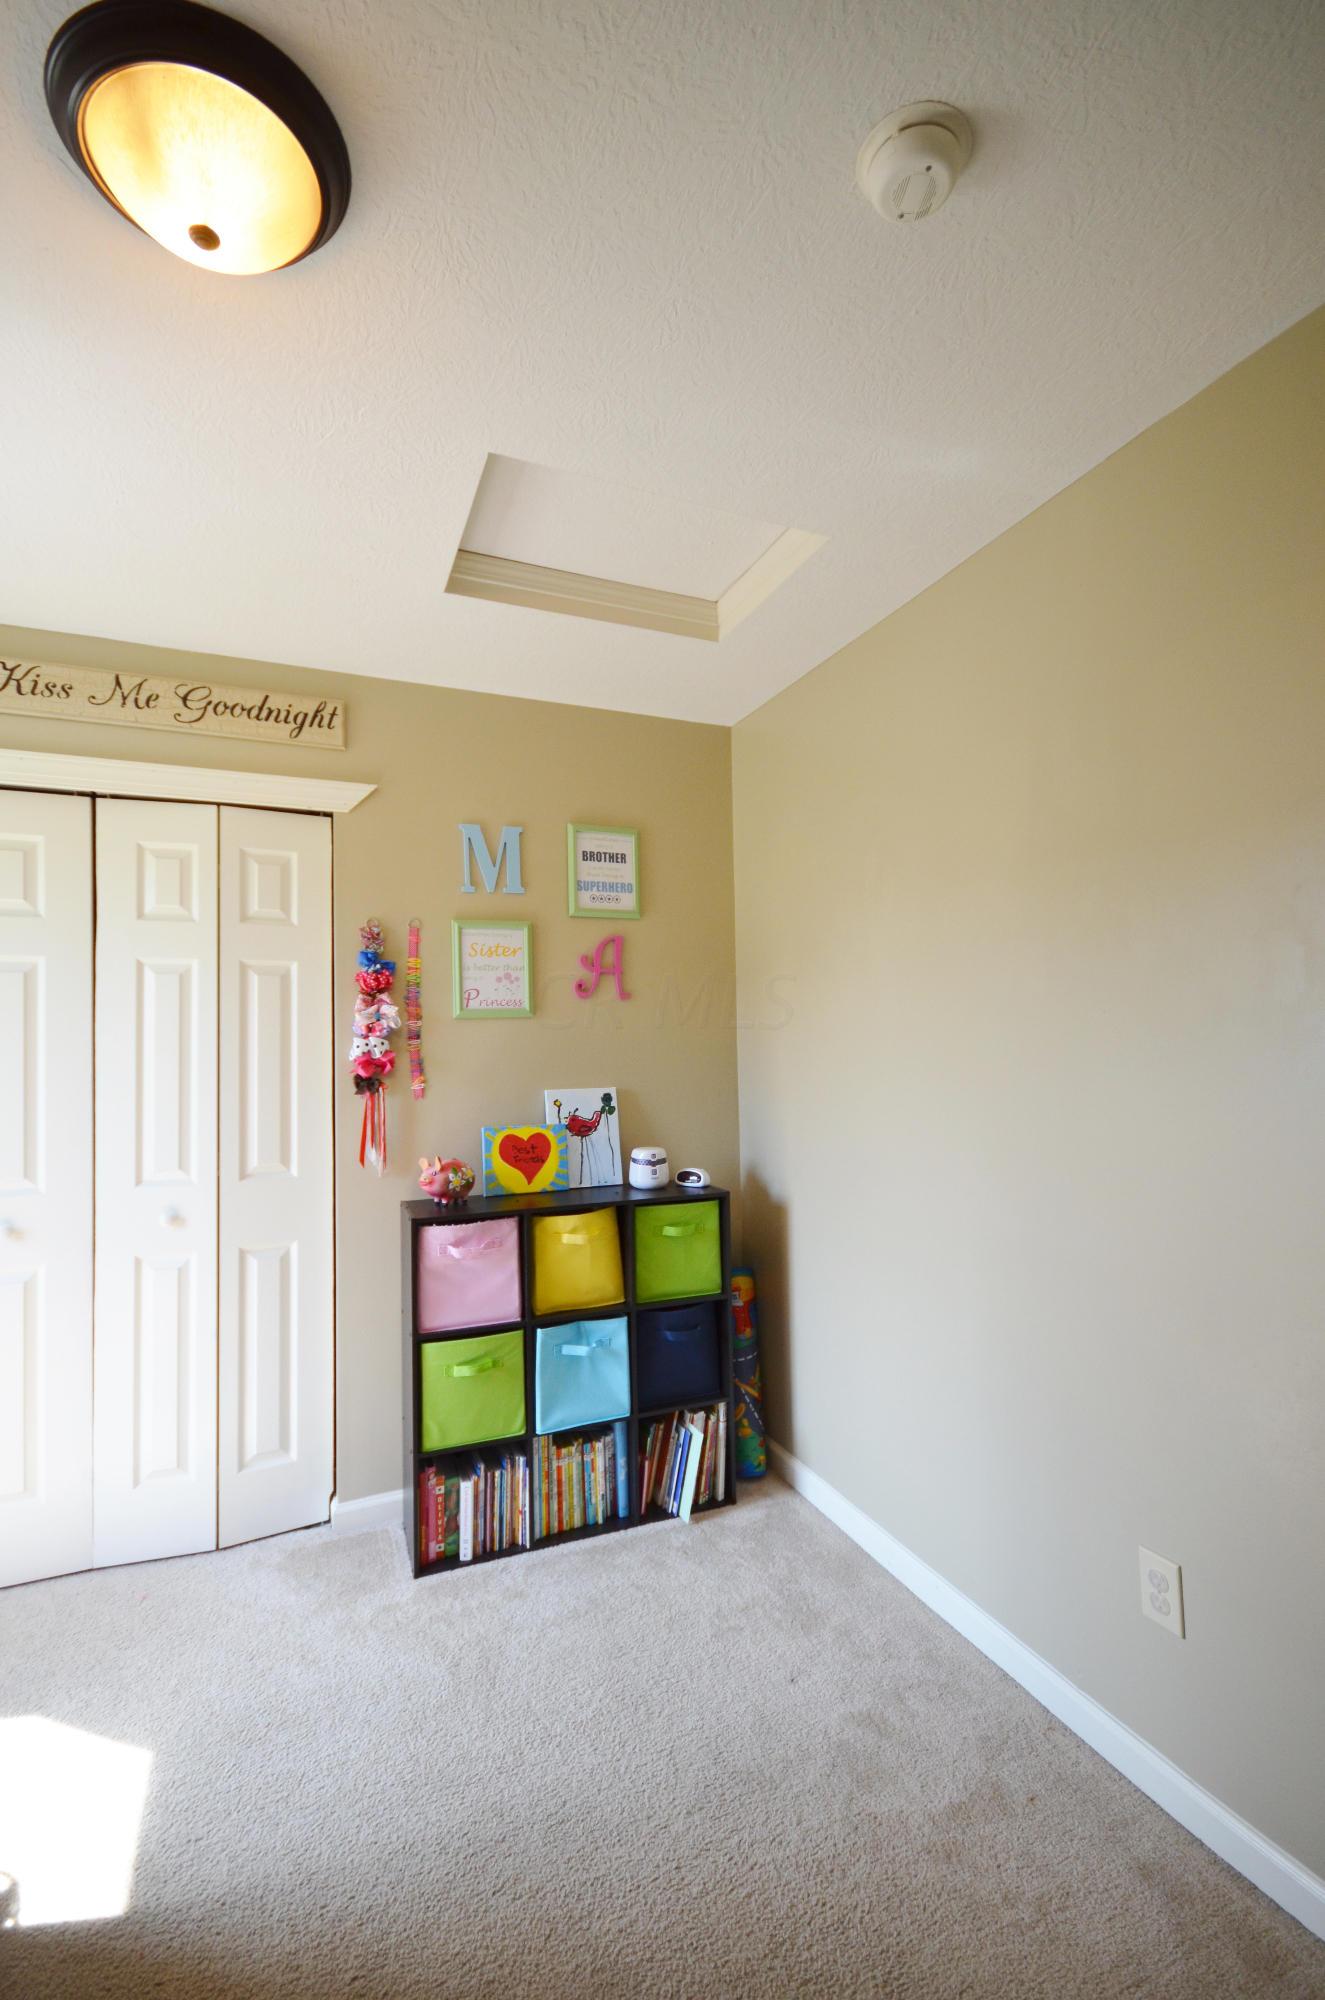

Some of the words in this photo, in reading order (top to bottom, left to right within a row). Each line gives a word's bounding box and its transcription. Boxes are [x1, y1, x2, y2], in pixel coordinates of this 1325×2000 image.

[0, 660, 74, 699] Kiss
[87, 673, 160, 710] Me
[173, 683, 339, 739] Goodnight
[458, 823, 525, 894] M
[581, 850, 627, 865] BROTHER
[576, 880, 634, 894] SUPERHERO
[468, 942, 523, 958] Sister
[574, 934, 632, 1001] A
[463, 988, 524, 1009] Princess
